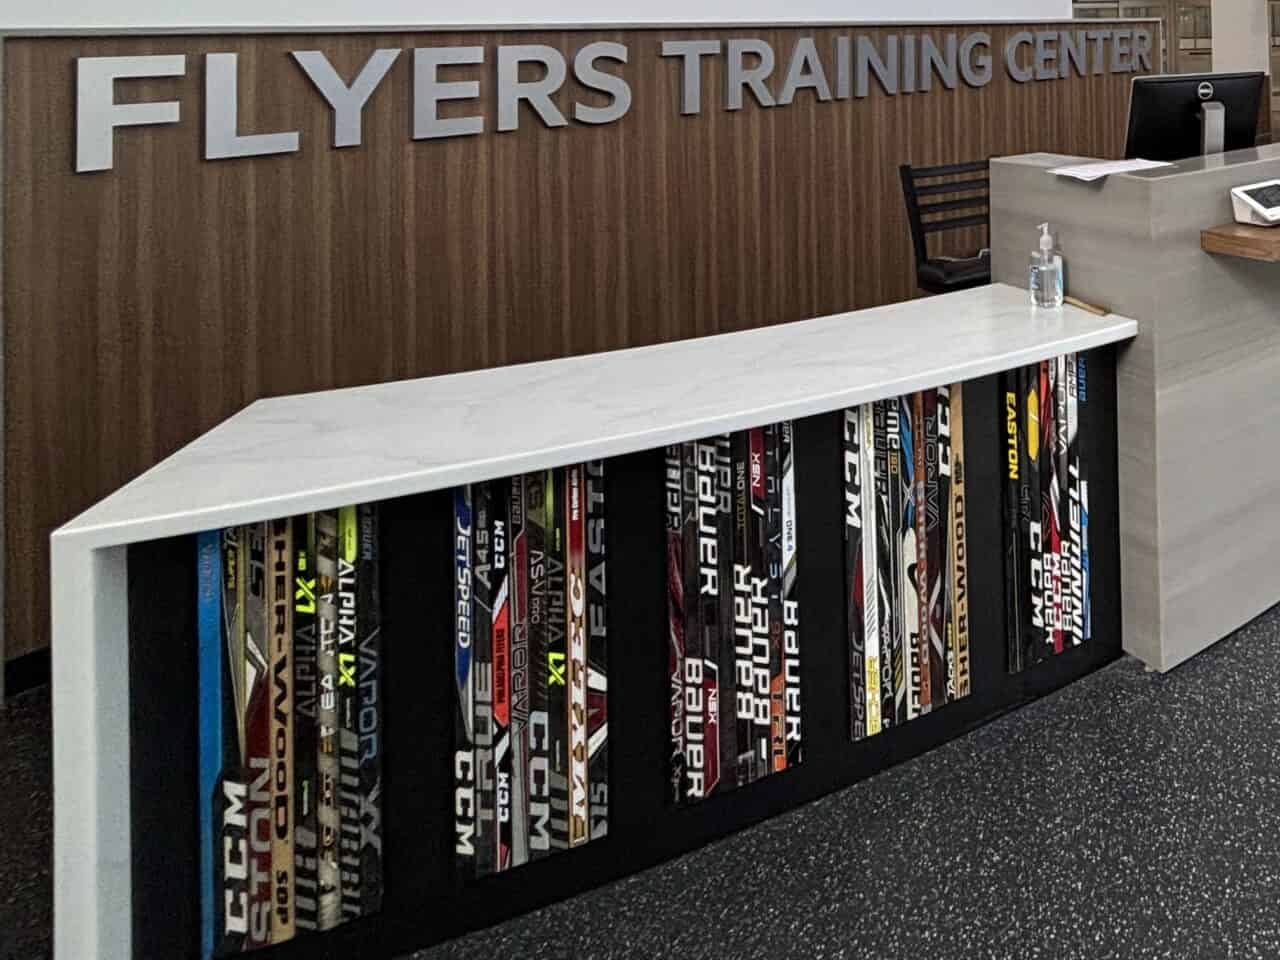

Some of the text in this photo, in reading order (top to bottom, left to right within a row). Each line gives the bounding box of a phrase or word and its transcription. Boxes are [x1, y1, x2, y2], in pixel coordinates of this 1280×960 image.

[76, 25, 1153, 174] FLYERS TRAINING CENTER
[844, 408, 861, 528] CCM
[926, 415, 939, 532] VAPOR
[1006, 390, 1019, 480] EASTON
[456, 516, 470, 648] JETSPEED
[494, 520, 505, 569] CCM
[699, 446, 720, 595] BAUER
[1030, 519, 1043, 627] CCM
[1060, 539, 1073, 632] BAUER
[295, 576, 316, 615] LX
[337, 558, 356, 688] ALPHA LX
[547, 558, 565, 686] ALPHA LX
[733, 563, 753, 720] BAUER
[751, 576, 771, 725] BAUER
[954, 495, 969, 695] SHER-WOOD
[273, 518, 289, 841] SHER-WOOD
[295, 624, 316, 718] ALPHA
[359, 625, 380, 764] VAPOR
[570, 571, 585, 822] MYLEC
[686, 658, 704, 798] BAUER
[784, 600, 801, 742] BAUER
[455, 750, 474, 856] CCM
[475, 661, 493, 837] TRUE
[496, 772, 509, 824] CCM
[529, 711, 549, 850] CCM
[223, 781, 249, 936] CCM
